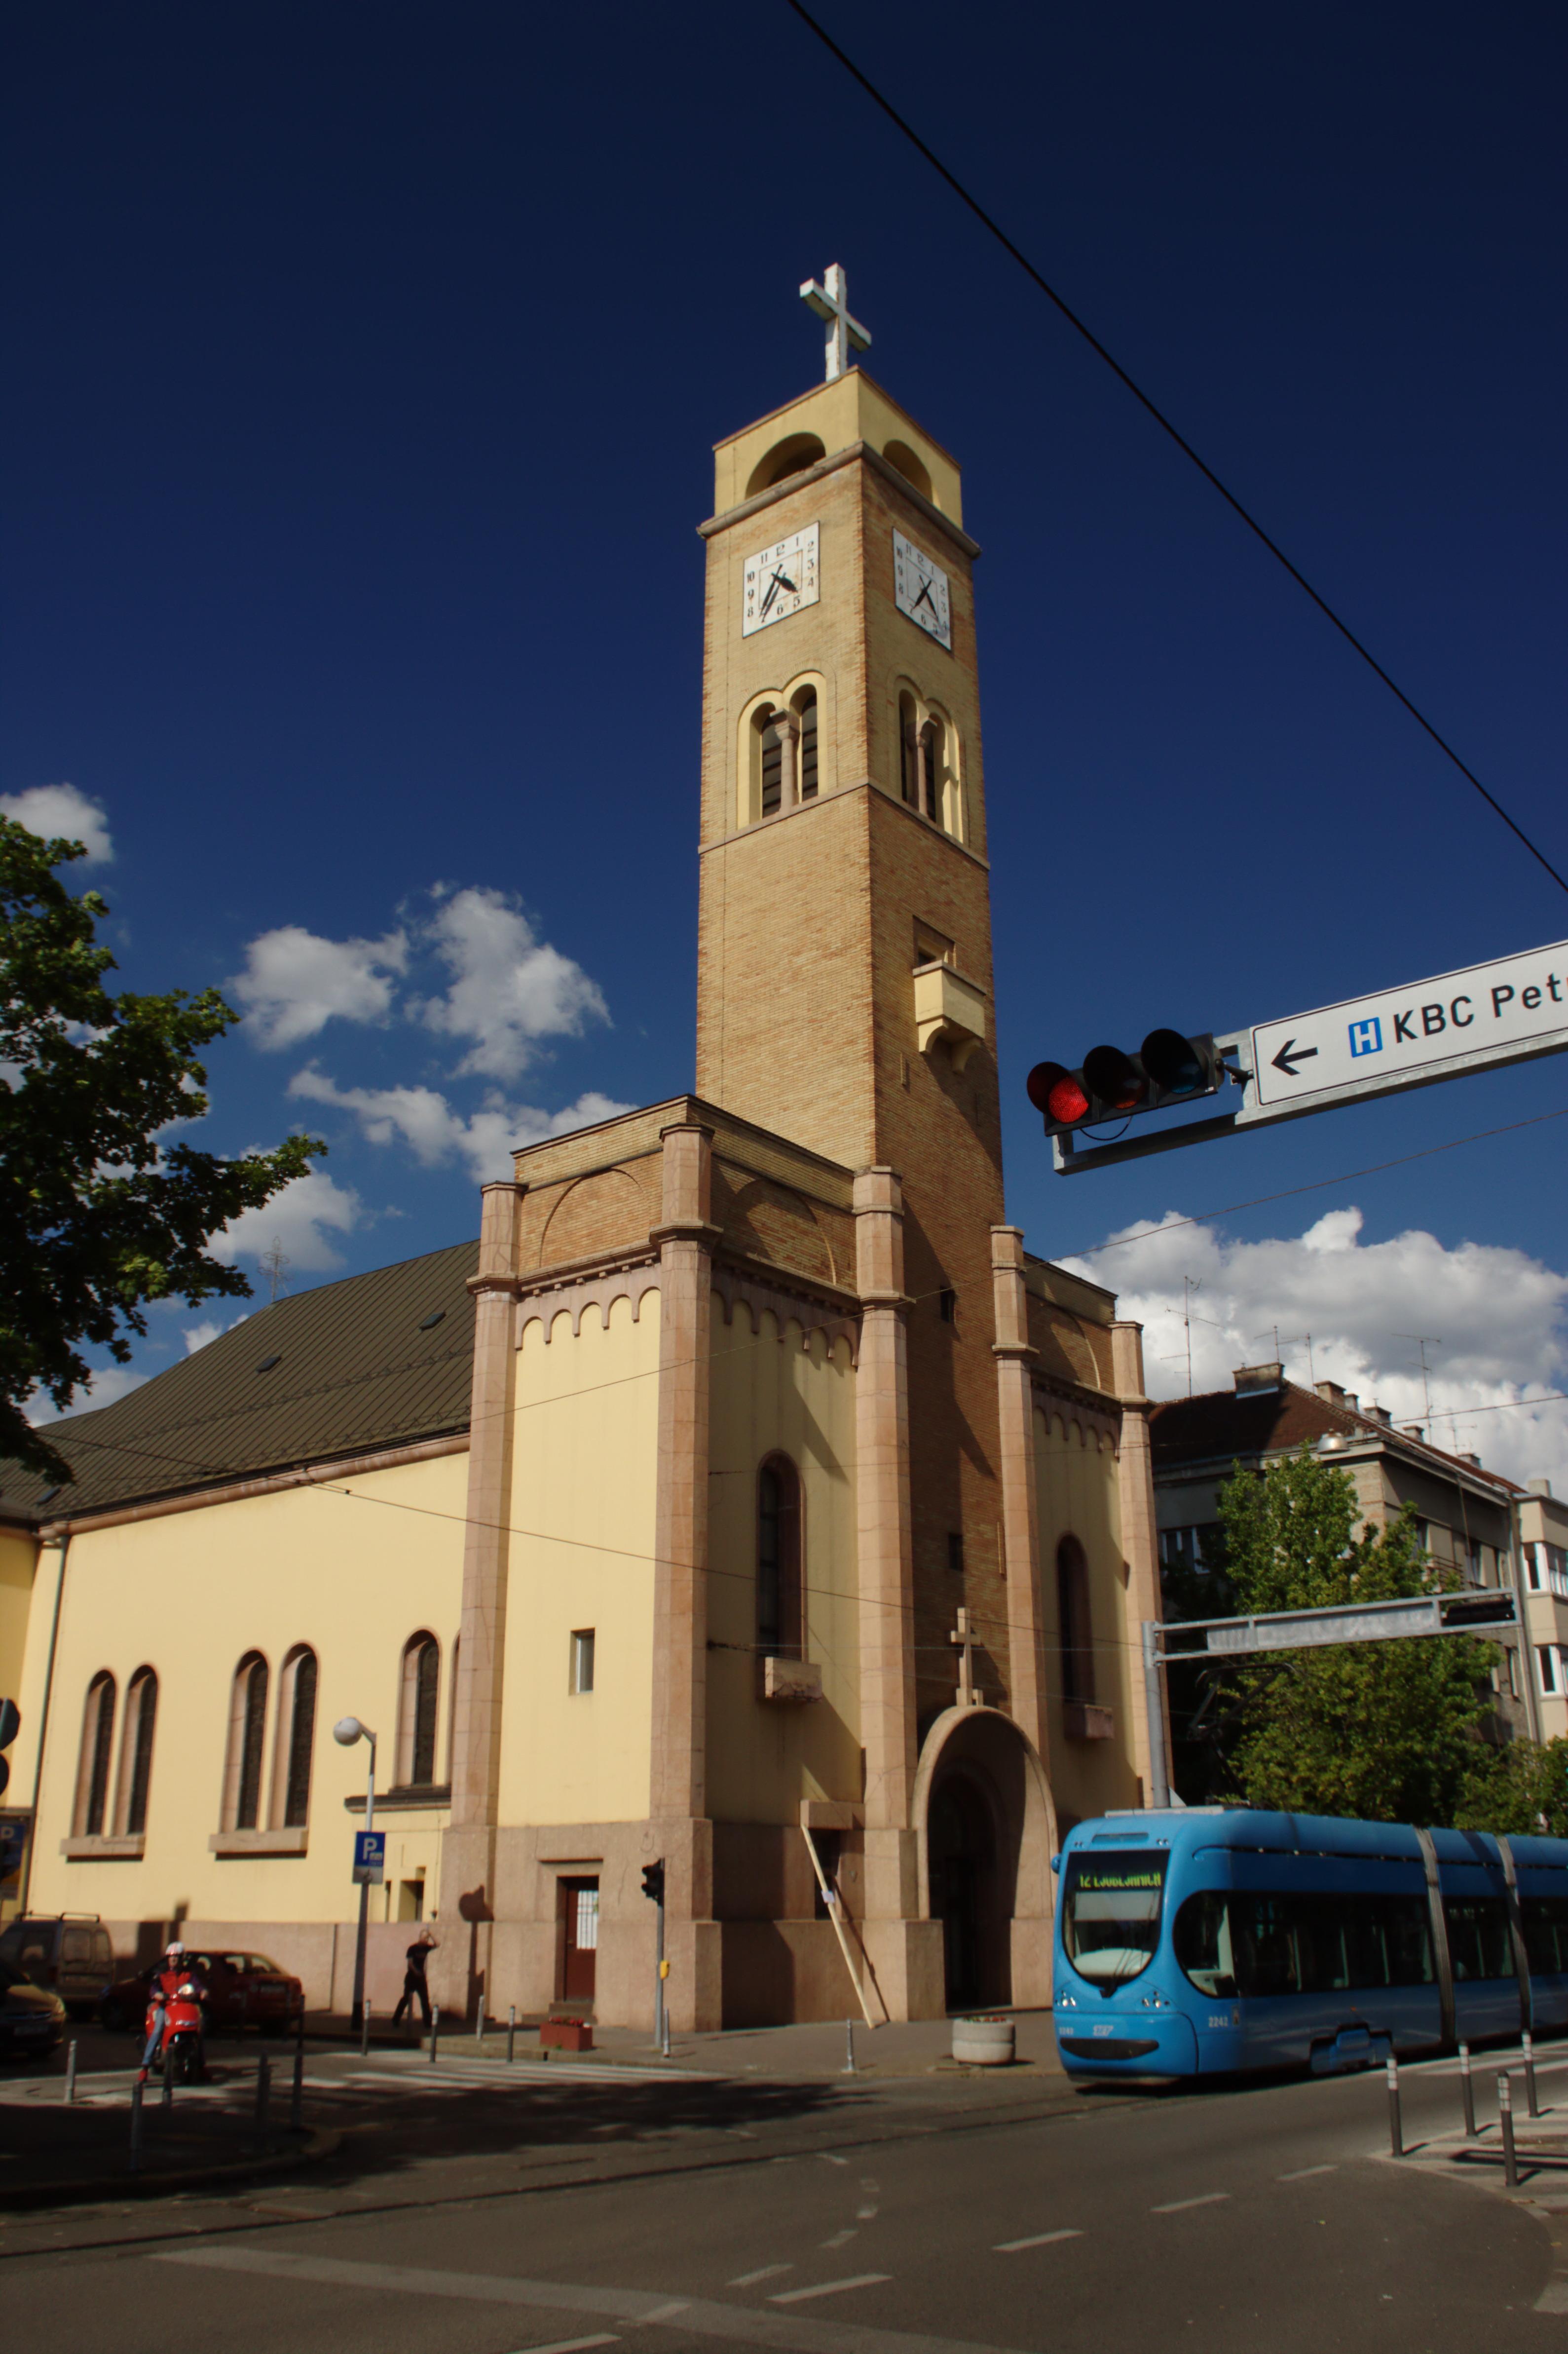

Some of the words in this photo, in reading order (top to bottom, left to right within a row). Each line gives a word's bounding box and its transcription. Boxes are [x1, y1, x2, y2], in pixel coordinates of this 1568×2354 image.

[776, 543, 785, 556] 12
[808, 540, 814, 552] 2
[906, 543, 912, 556] 11
[761, 552, 768, 564] 11
[808, 558, 814, 570] 3
[917, 553, 924, 567] 12
[747, 570, 755, 583] 10
[808, 576, 814, 587] 4
[747, 589, 754, 600] 9
[793, 595, 800, 608] 5
[747, 607, 754, 617] 8
[777, 604, 784, 615] 6
[1353, 1021, 1378, 1054] H
[1393, 995, 1474, 1044] KBC
[1491, 973, 1568, 1018] Pet
[363, 1838, 377, 1860] P
